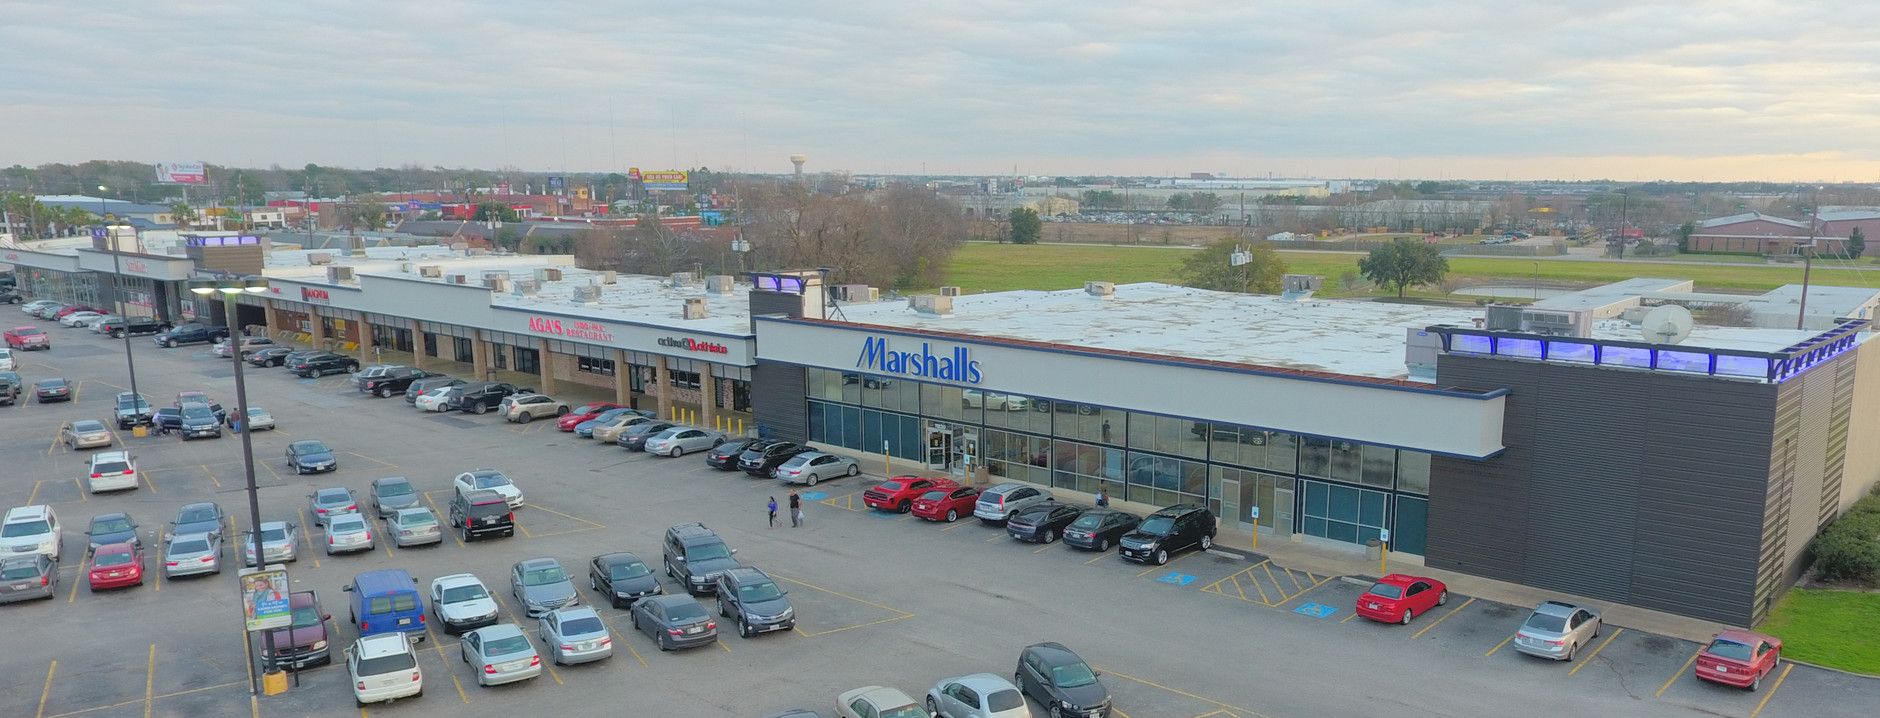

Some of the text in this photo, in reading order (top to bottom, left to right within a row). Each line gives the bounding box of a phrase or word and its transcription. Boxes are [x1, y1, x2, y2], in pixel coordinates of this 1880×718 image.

[529, 317, 563, 335] AGA'S
[566, 328, 613, 342] RESTAURANT
[856, 336, 981, 384] Marshalls
